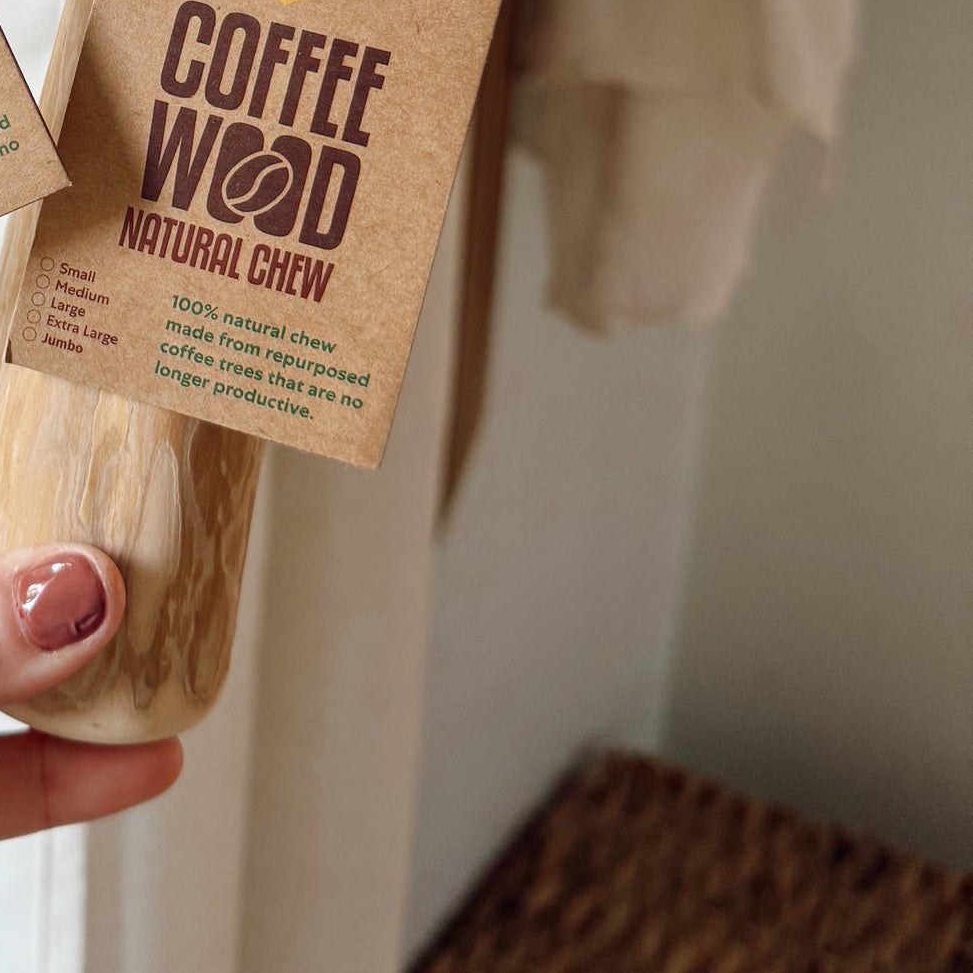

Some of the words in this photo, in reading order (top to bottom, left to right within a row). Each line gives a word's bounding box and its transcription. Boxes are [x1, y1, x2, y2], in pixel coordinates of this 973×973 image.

[160, 0, 391, 147] COFFEE
[141, 99, 361, 250] WOOD
[59, 262, 96, 283] Small
[118, 206, 243, 279] NATURAL
[247, 243, 335, 303] CHEW
[50, 297, 86, 317] Large
[55, 279, 110, 305] Medium
[41, 333, 83, 353] Jumbo
[46, 314, 79, 334] Extra
[83, 325, 118, 345] Large
[165, 319, 214, 343] made
[218, 332, 260, 357] from
[265, 348, 371, 387] repurposed
[172, 294, 218, 320] 100%
[223, 313, 286, 339] natural
[290, 331, 336, 354] chew
[154, 360, 209, 388] longer
[212, 380, 314, 419] productive.
[160, 342, 214, 366] coffee
[219, 358, 263, 381] trees
[268, 372, 304, 393] that
[308, 384, 336, 402] are
[340, 393, 363, 410] no
